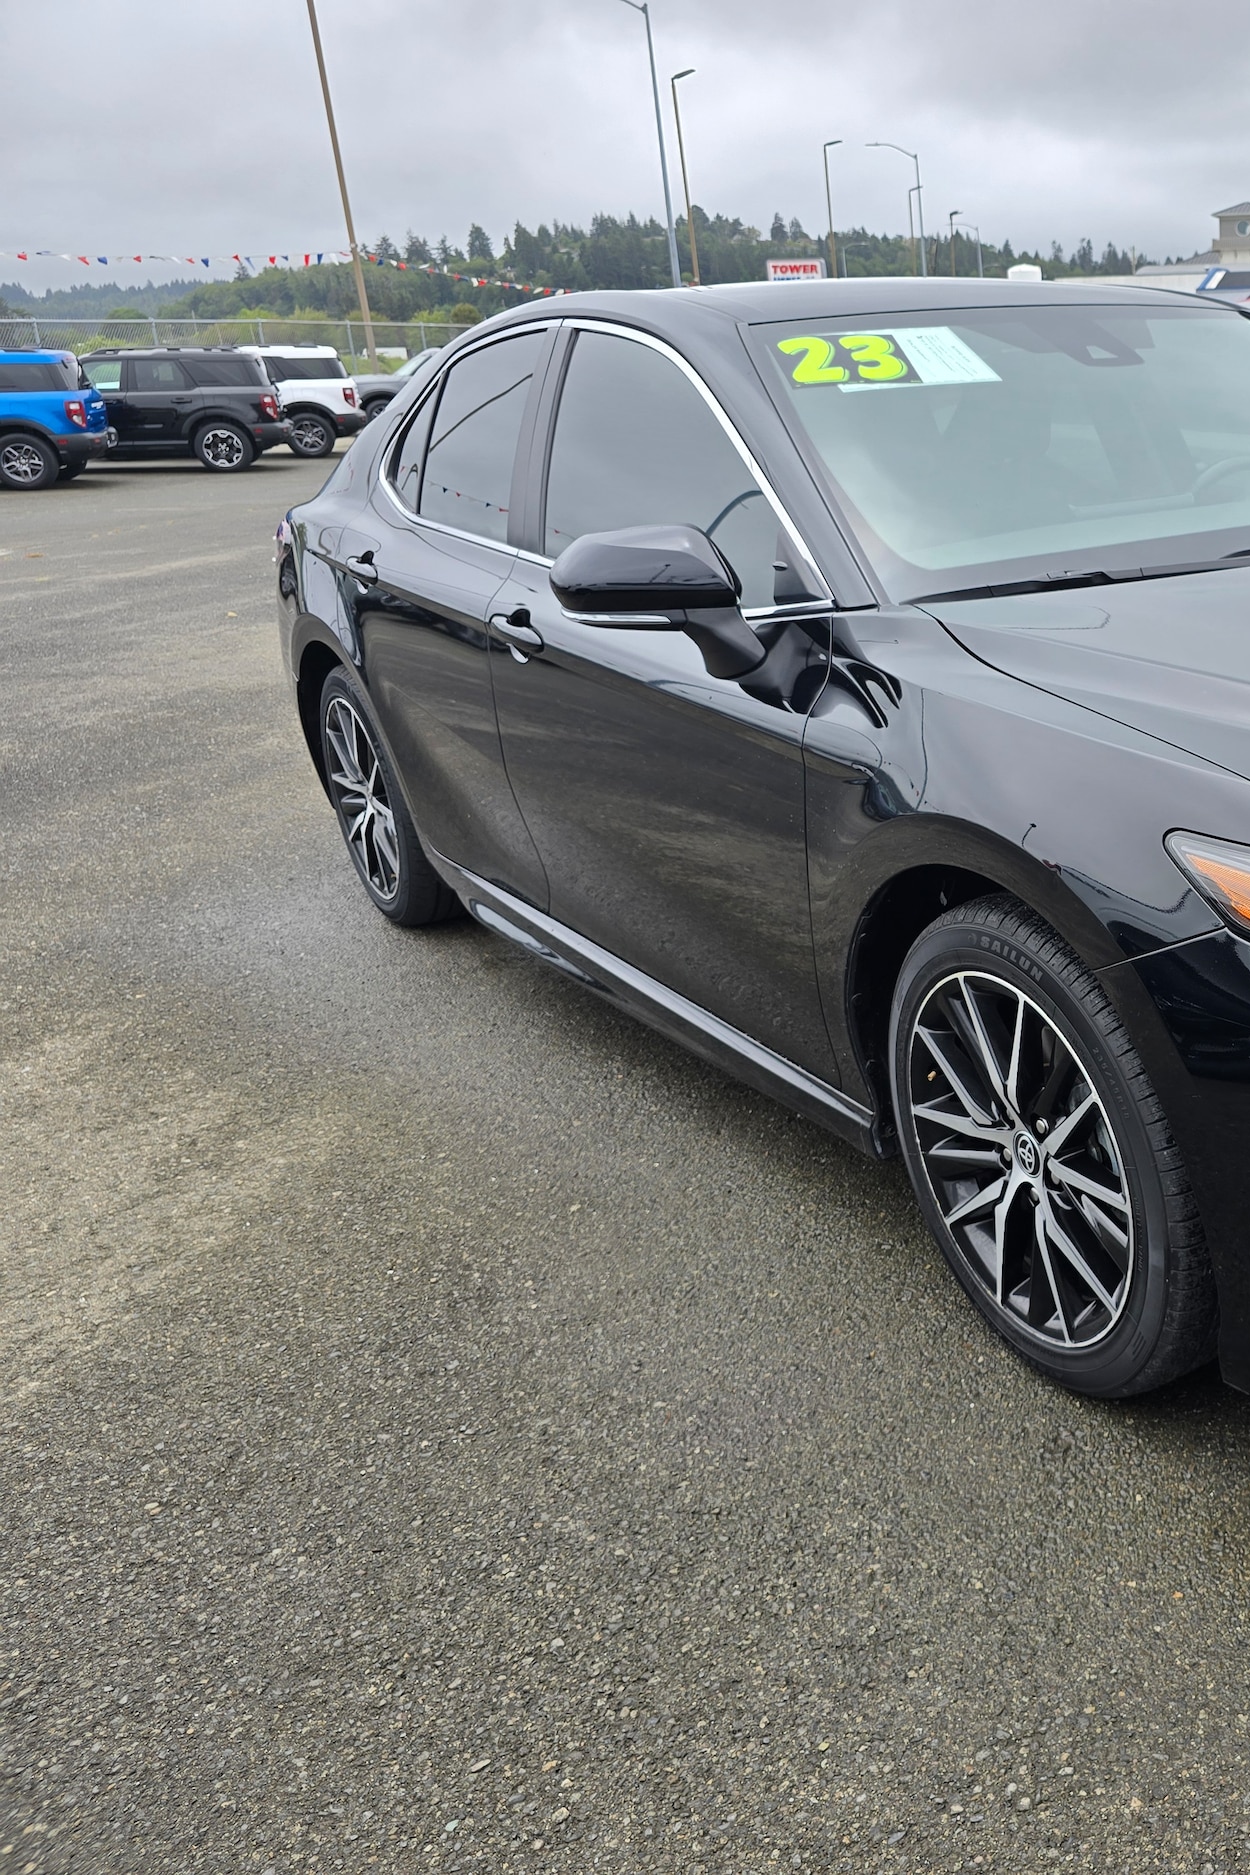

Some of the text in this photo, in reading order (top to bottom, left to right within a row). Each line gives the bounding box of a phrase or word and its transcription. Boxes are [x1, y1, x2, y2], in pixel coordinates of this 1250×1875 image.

[772, 264, 818, 274] TOWER
[776, 335, 908, 385] 23
[980, 935, 1044, 982] SAILUN
